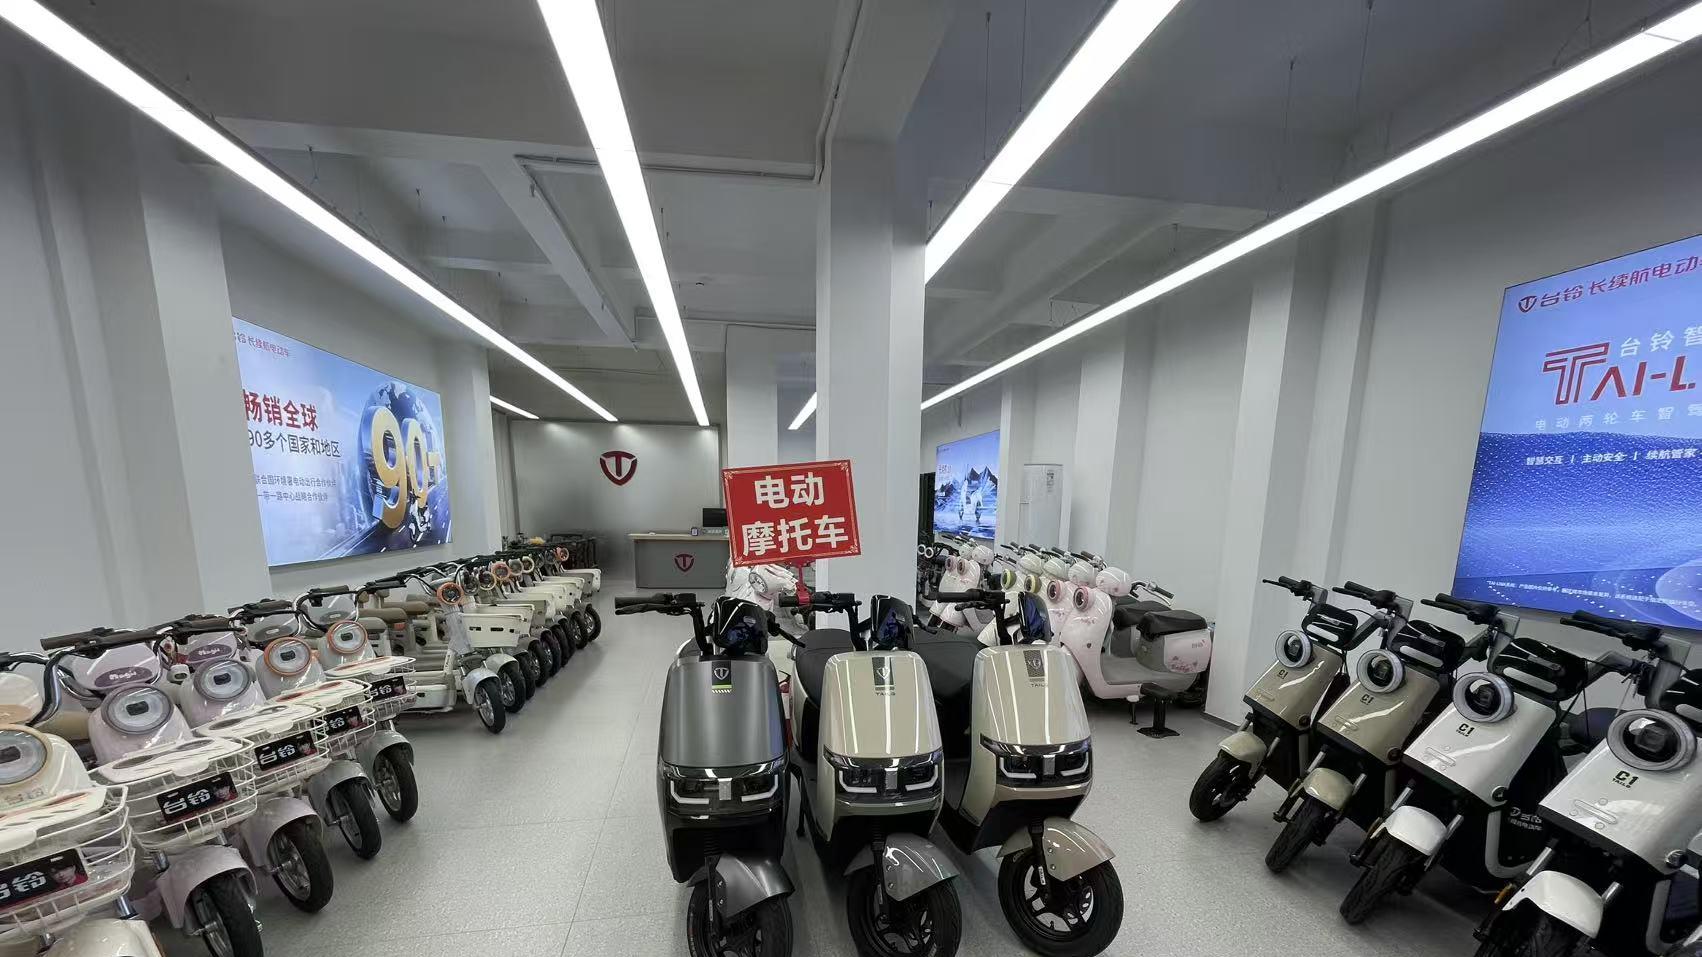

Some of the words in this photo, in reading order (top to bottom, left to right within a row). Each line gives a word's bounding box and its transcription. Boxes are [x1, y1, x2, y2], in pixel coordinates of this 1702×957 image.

[1540, 285, 1584, 307] 台铃
[1589, 255, 1702, 295] 长续航电动
[242, 389, 319, 432] 畅销全球
[247, 428, 342, 458] 90多个国家和地区
[1581, 451, 1627, 464] 主动安全
[754, 472, 825, 509] 电动
[741, 514, 849, 557] 摩托车
[1458, 723, 1475, 735] C1
[259, 744, 296, 765] 台铃
[1615, 770, 1639, 785] C1
[163, 788, 211, 815] 台铃
[0, 870, 47, 901] 铃
